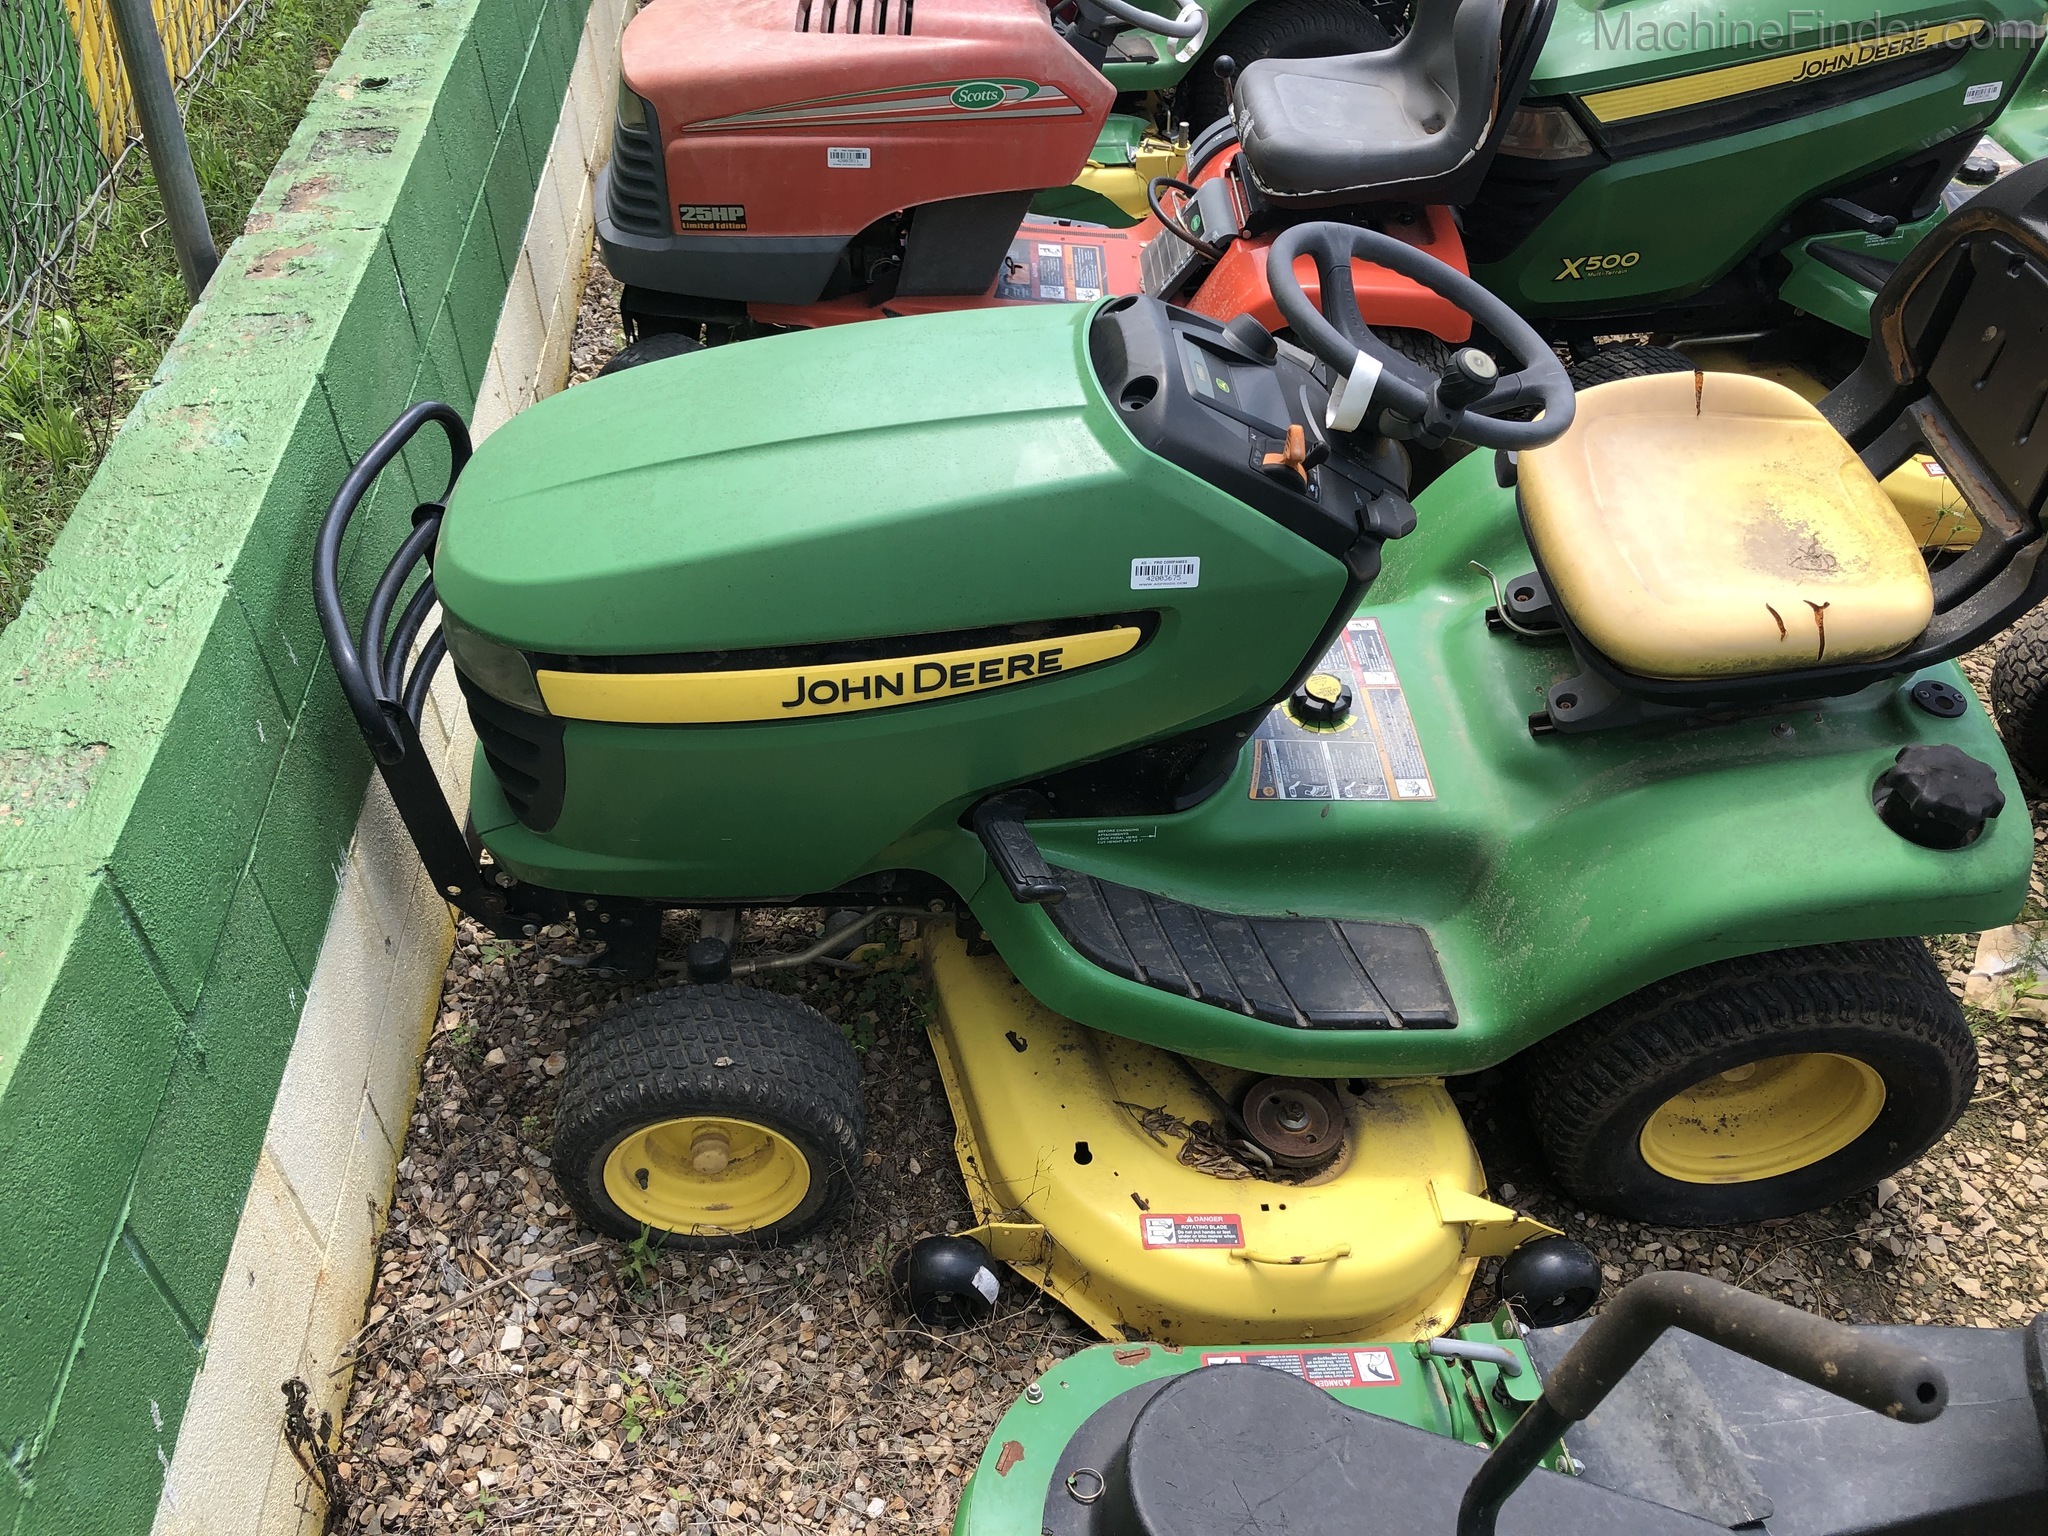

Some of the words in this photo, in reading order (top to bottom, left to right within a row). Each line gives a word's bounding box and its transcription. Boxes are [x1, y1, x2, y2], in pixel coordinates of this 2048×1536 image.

[1792, 52, 1853, 80] JOHN
[1858, 32, 1928, 63] DEERE
[958, 89, 999, 103] Scotts
[680, 206, 745, 221] 25HP
[1554, 252, 1641, 281] X500
[1587, 269, 1628, 277] Multi-Terrain
[781, 672, 904, 708] JOHN
[913, 647, 1064, 694] DEERE
[1314, 1379, 1344, 1388] DANGER
